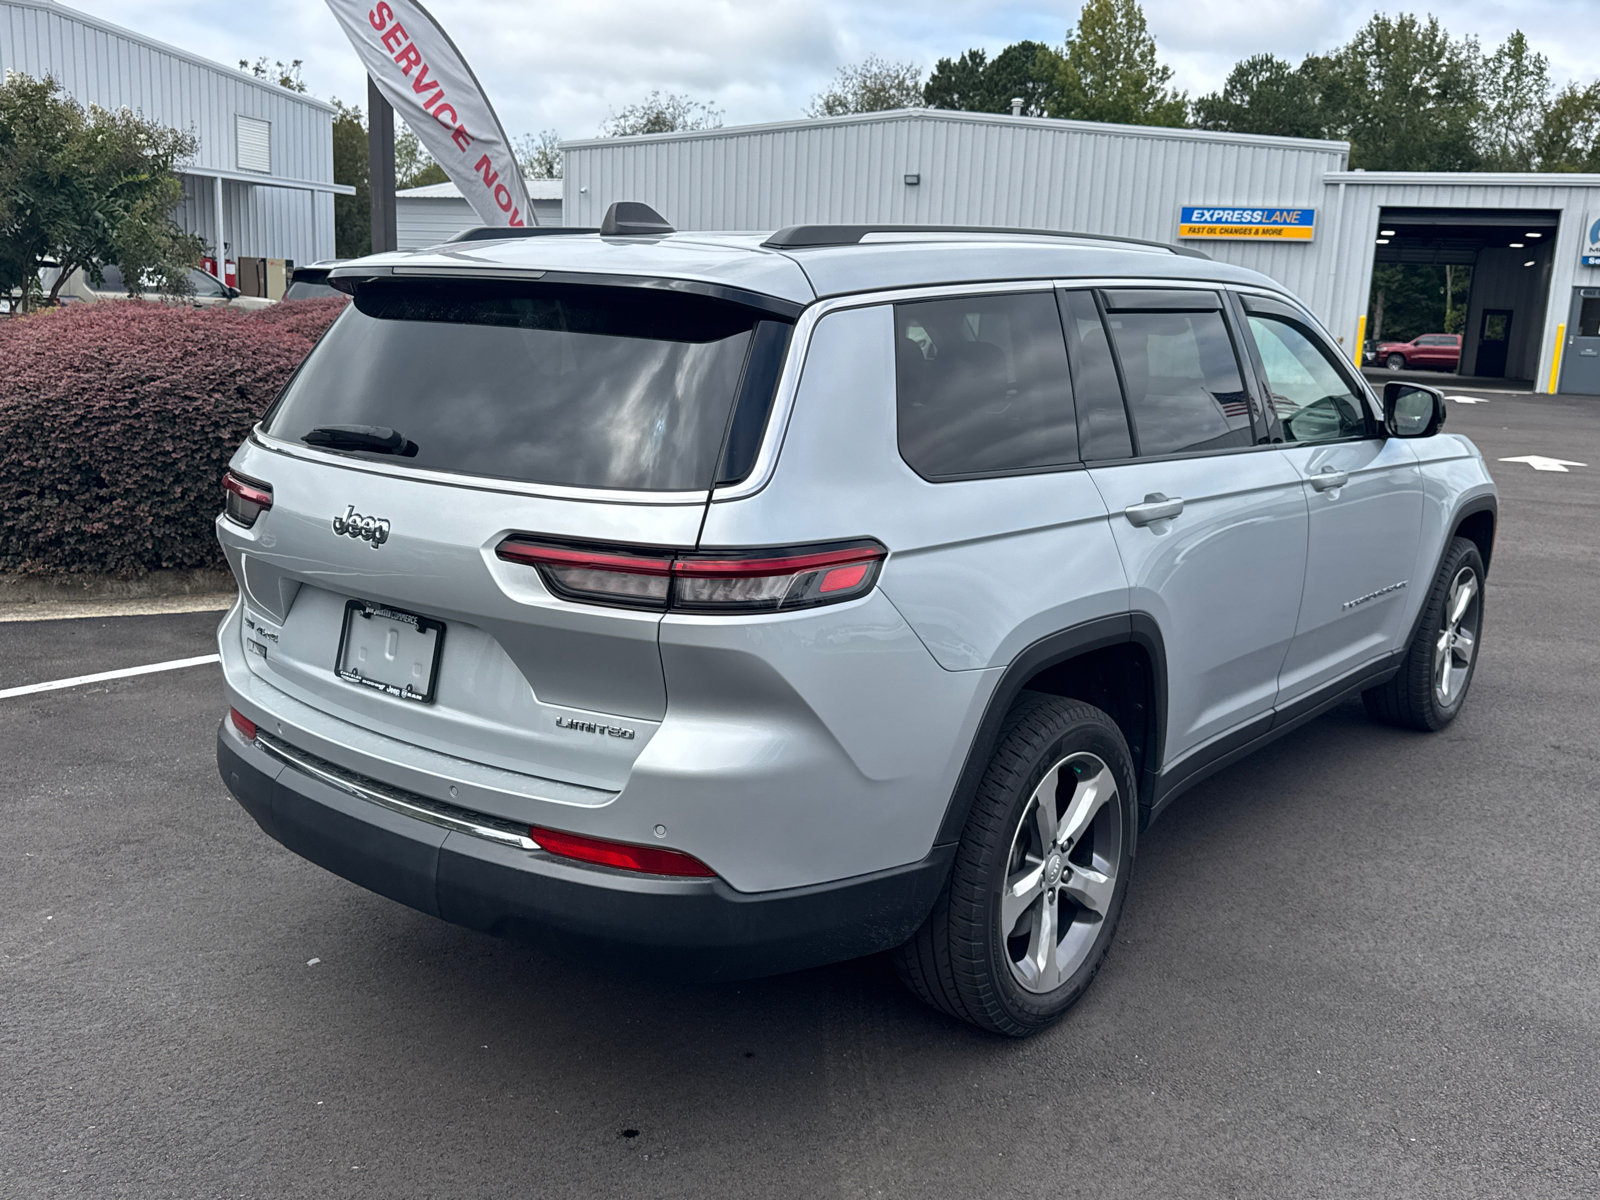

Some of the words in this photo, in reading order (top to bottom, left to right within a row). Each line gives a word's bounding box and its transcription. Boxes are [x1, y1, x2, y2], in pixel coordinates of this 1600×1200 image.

[368, 1, 475, 153] SERVICE
[1187, 226, 1205, 234] FAST
[1206, 227, 1217, 235] OIL
[1219, 227, 1252, 236] CHANGES
[1261, 228, 1284, 236] MORE
[333, 504, 391, 549] Jeep
[386, 685, 401, 697] Jeep
[407, 692, 423, 700] RAM
[556, 717, 635, 740] LIMITED
